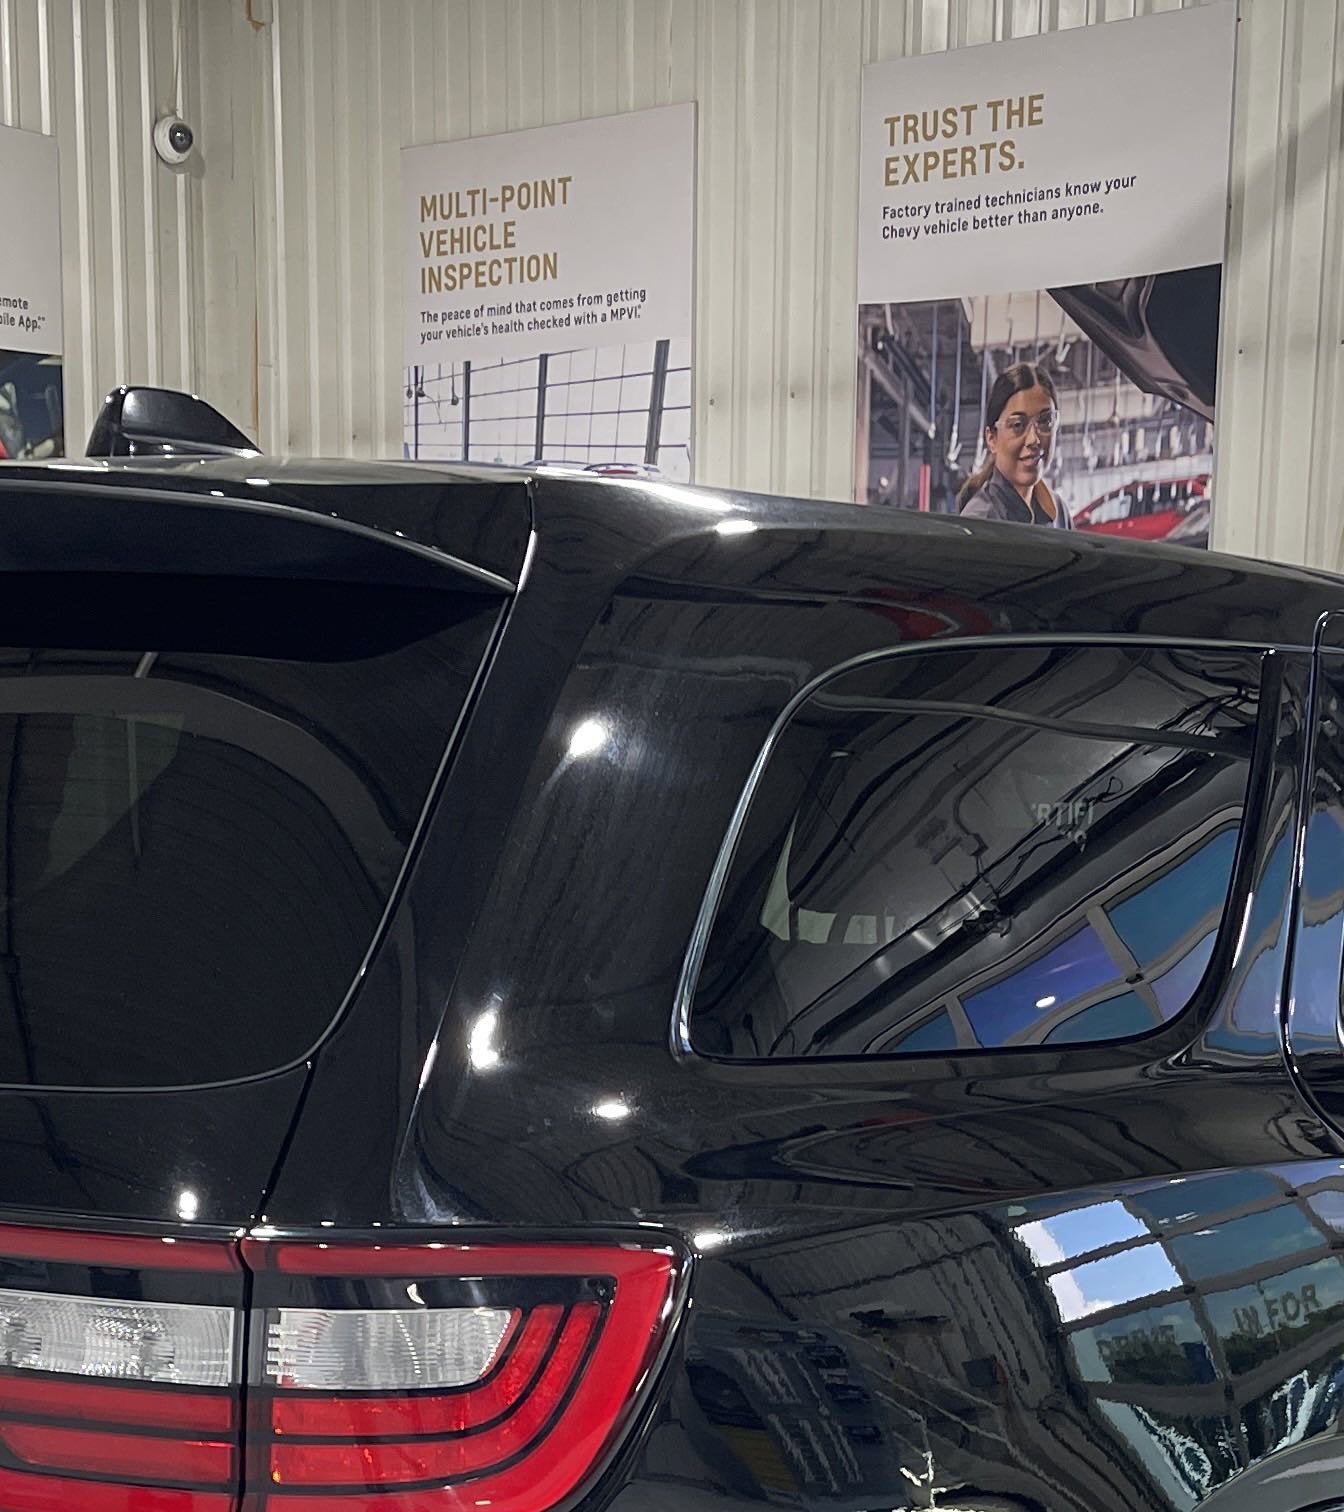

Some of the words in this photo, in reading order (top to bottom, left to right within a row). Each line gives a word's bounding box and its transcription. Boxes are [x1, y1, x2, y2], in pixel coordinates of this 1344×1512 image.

[884, 104, 978, 147] TRUST
[987, 93, 1045, 132] THE
[884, 140, 1025, 187] EXPERTS.
[420, 176, 573, 223] MULTI-POINT
[882, 203, 932, 220] Factory
[934, 195, 981, 214] trained
[984, 185, 1061, 209] technicians
[1064, 181, 1102, 198] know
[1104, 174, 1137, 194] your
[420, 221, 516, 258] VEHICLE
[882, 223, 920, 240] Chevy
[923, 217, 969, 236] vehicle
[972, 212, 1014, 231] better
[1017, 207, 1047, 224] than
[1051, 202, 1104, 224] anyone.
[421, 252, 558, 294] INSPECTION
[420, 310, 438, 325] The
[441, 307, 471, 326] peace
[474, 304, 485, 318] of
[487, 302, 512, 317] mind
[515, 299, 537, 315] that
[540, 295, 574, 312] comes
[577, 292, 603, 308] from
[607, 288, 647, 307] getting
[420, 328, 443, 345] your
[445, 321, 489, 339] vehicle's
[491, 318, 525, 335] health
[527, 314, 571, 331] checked
[574, 310, 598, 326] with
[601, 312, 607, 323] a
